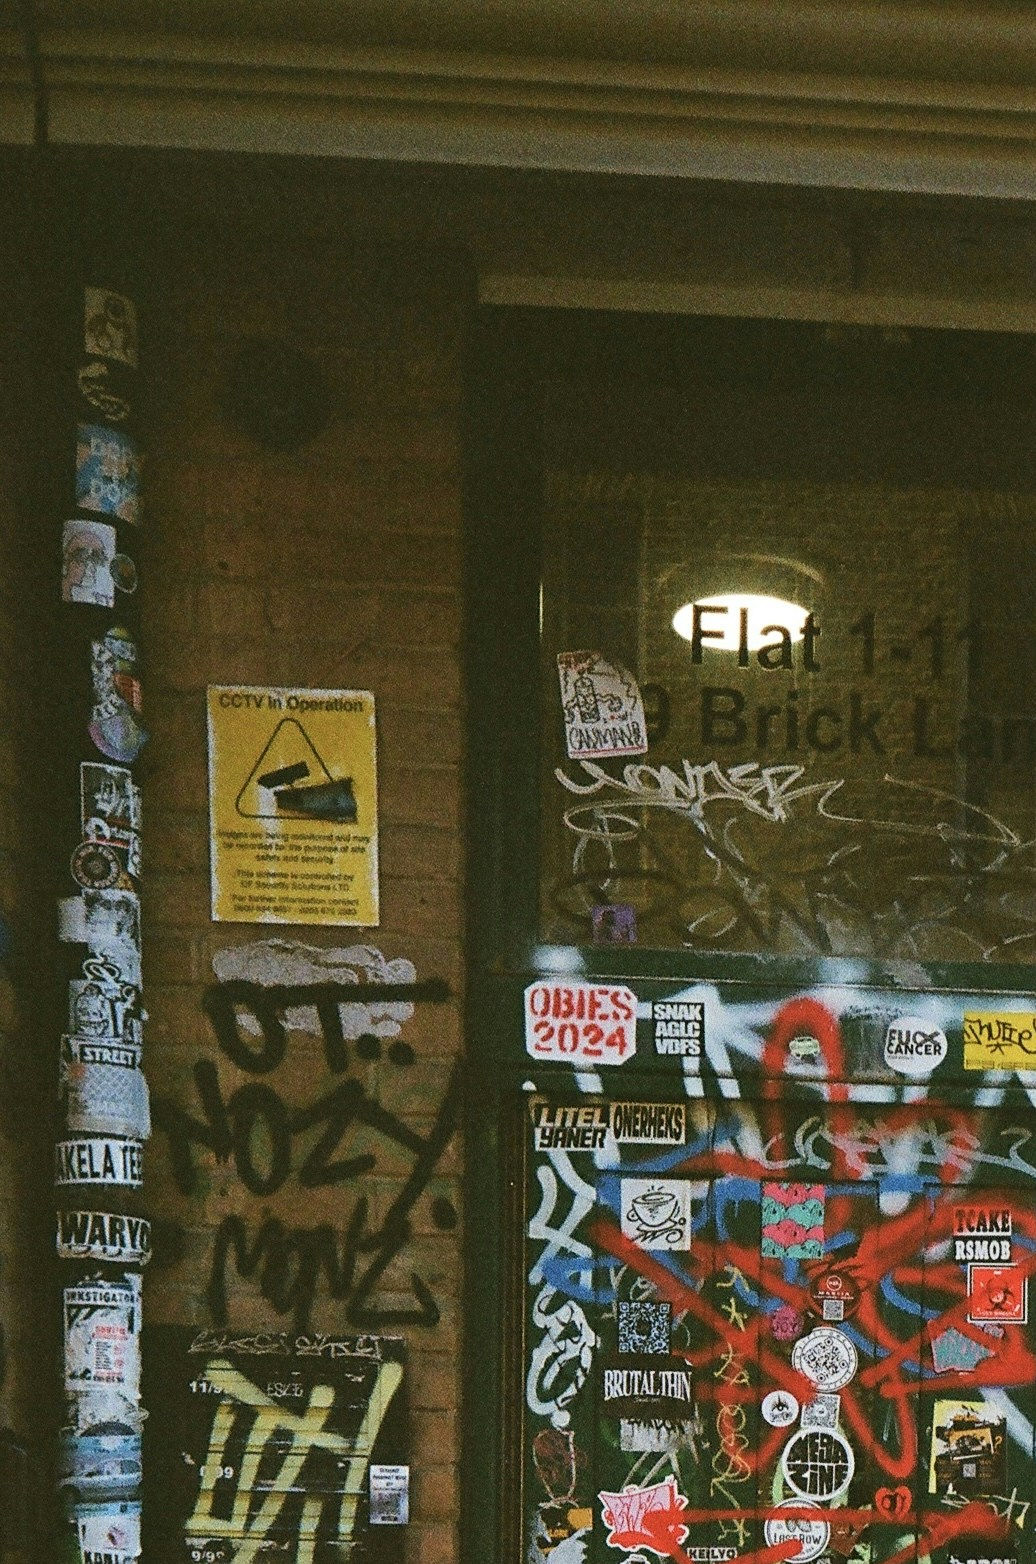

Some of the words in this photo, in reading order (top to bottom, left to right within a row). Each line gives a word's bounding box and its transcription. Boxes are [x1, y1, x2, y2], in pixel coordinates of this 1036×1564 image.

[690, 604, 821, 672] Flat
[852, 610, 985, 676] 1-11
[219, 693, 265, 710] CCTV
[268, 696, 283, 710] In
[286, 697, 364, 713] Operation
[700, 686, 881, 756] Brick
[529, 987, 633, 1021] OBIES
[653, 1003, 702, 1022] SNAK
[533, 1020, 628, 1057] 2024
[655, 1021, 701, 1038] AGLC
[83, 1046, 135, 1067] STREET
[655, 1037, 702, 1056] VDFS
[886, 1042, 942, 1057] CANCER
[539, 1106, 609, 1129] LITEL
[954, 1239, 1011, 1261] RSMOB
[603, 1369, 655, 1402] BRUTAL
[658, 1371, 692, 1403] THIN
[799, 1533, 822, 1545] ROW
